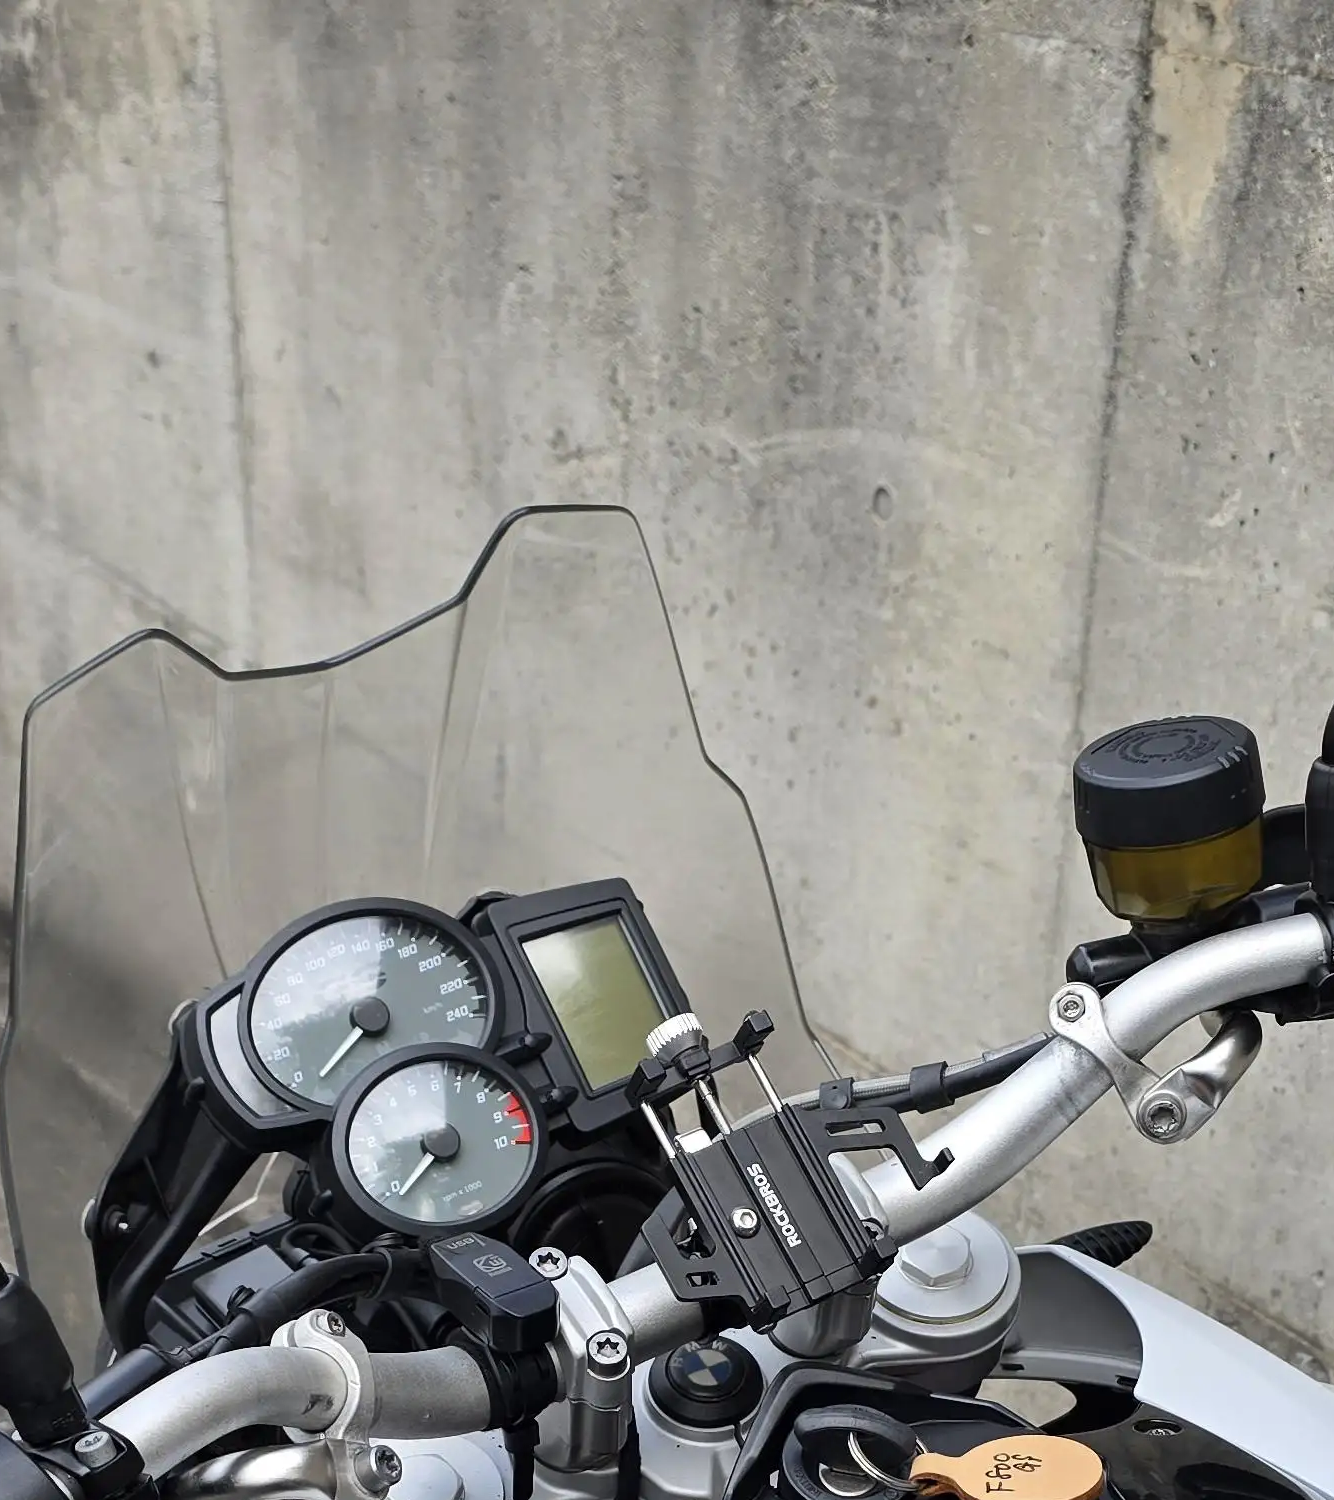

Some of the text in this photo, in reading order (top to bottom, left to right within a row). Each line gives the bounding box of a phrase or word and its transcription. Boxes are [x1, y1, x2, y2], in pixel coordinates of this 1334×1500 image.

[351, 939, 372, 955] 140
[374, 936, 396, 955] 160
[398, 943, 418, 960] 180
[305, 956, 326, 972] 100
[418, 955, 443, 973] 200
[439, 977, 463, 995] 220
[445, 1004, 469, 1022] 240
[273, 1045, 291, 1061] 20
[293, 1070, 304, 1083] 0
[746, 1163, 802, 1248] ROCKBROS
[446, 1237, 475, 1251] USB
